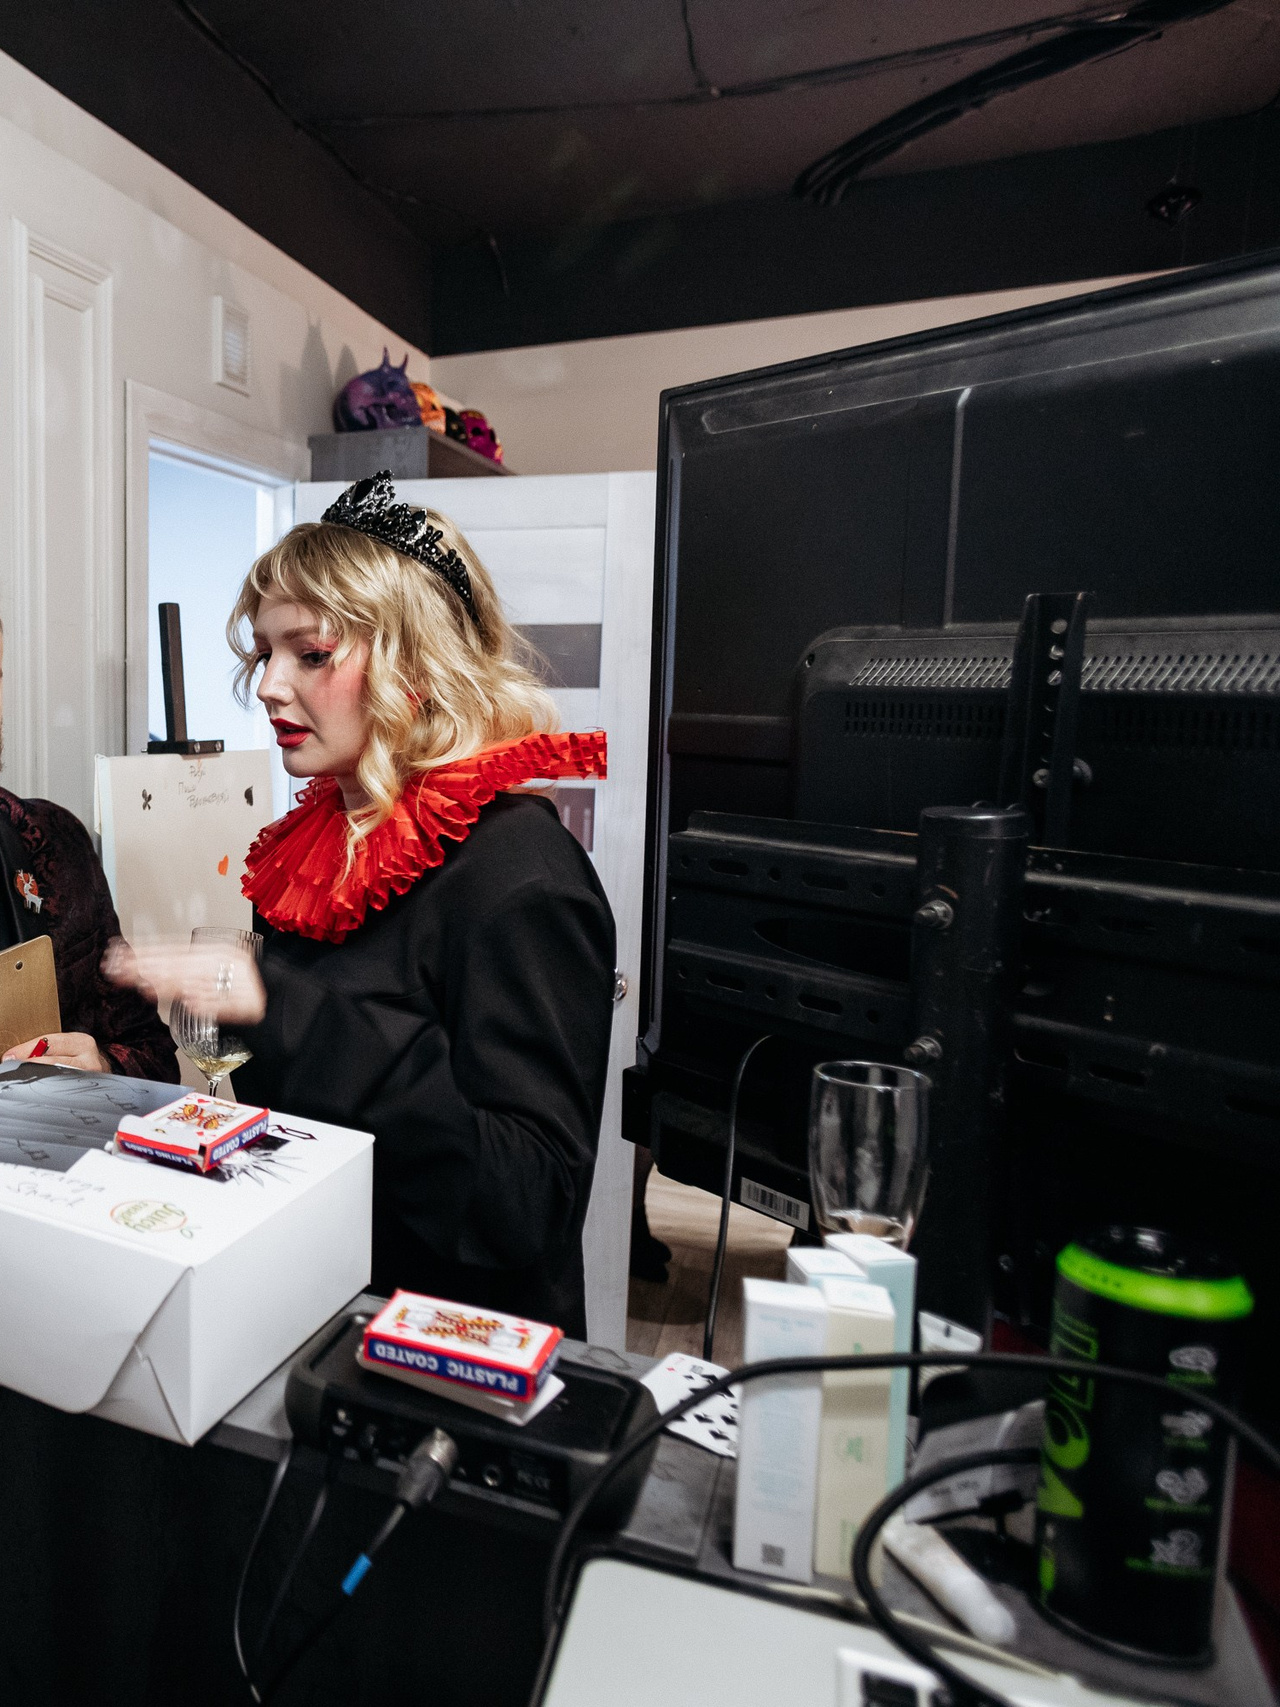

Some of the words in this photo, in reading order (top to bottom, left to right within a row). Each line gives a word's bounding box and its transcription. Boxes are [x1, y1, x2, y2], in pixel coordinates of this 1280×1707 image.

[242, 1118, 269, 1144] PLASTIC
[212, 1137, 240, 1161] COATED
[374, 1342, 440, 1372] COATED
[446, 1360, 519, 1392] PLASTIC
